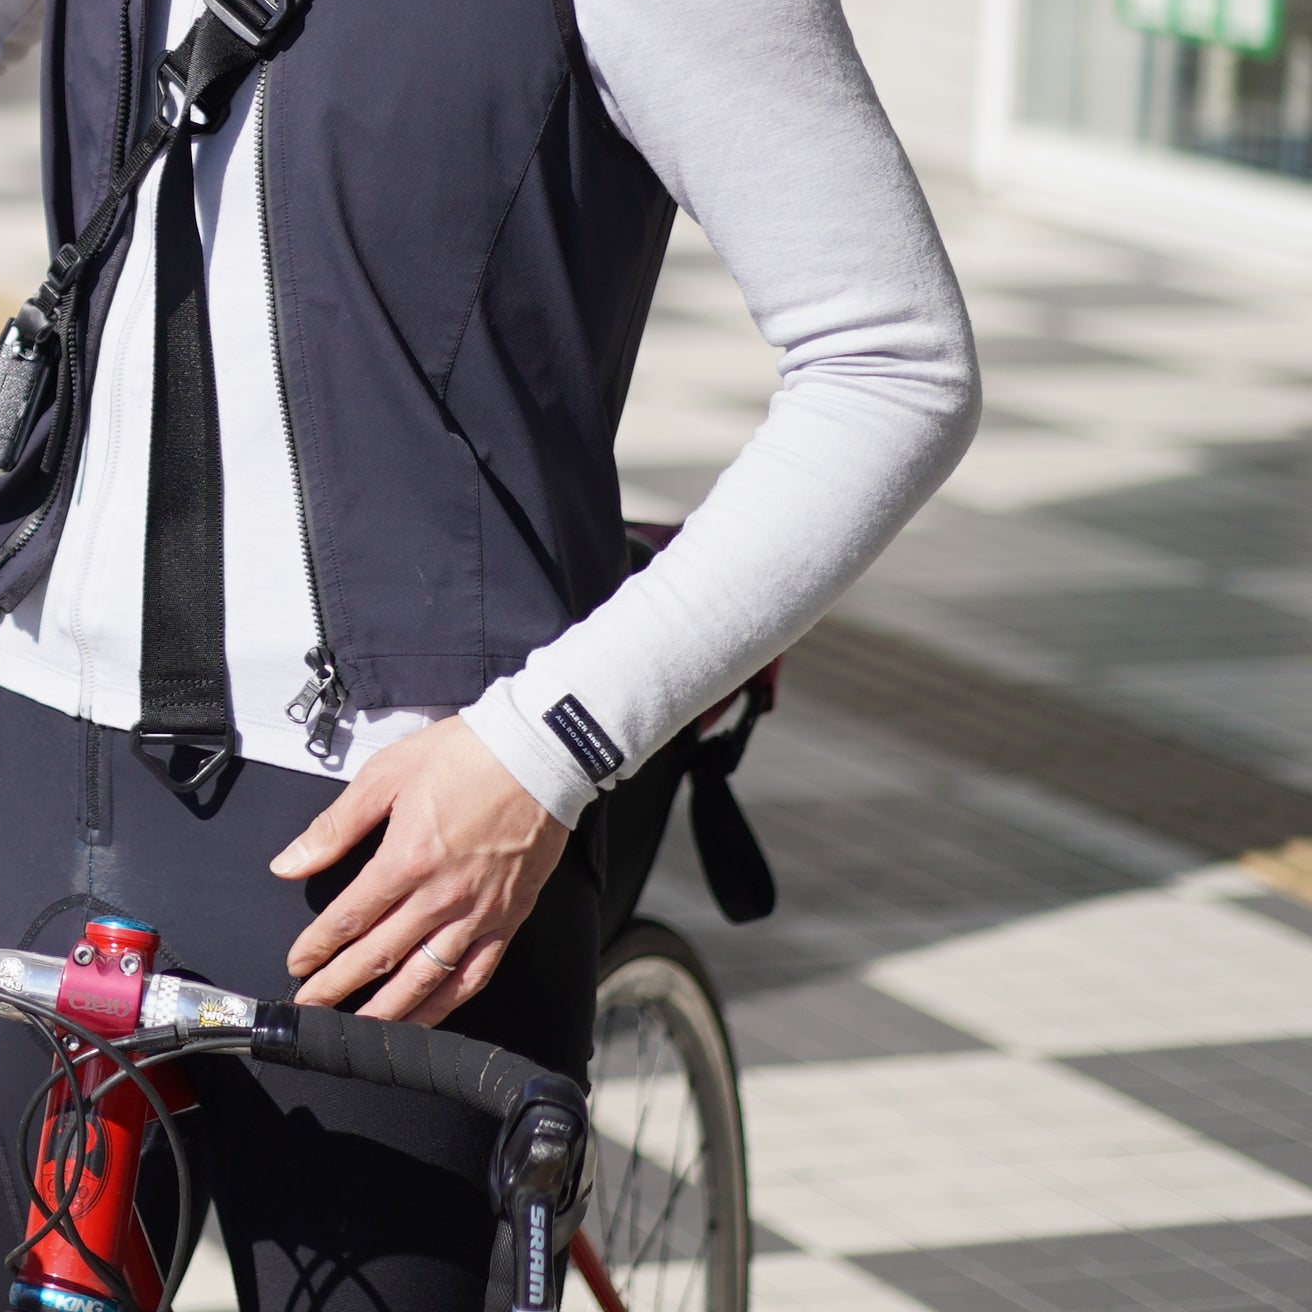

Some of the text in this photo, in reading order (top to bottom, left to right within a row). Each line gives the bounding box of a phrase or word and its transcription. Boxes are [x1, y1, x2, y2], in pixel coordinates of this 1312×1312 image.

[554, 714, 567, 728] ALL
[565, 726, 583, 747] ROAD
[562, 702, 588, 732] SEARCH
[586, 731, 600, 748] AND
[528, 1203, 547, 1307] SRAM
[54, 1293, 106, 1312] KING
